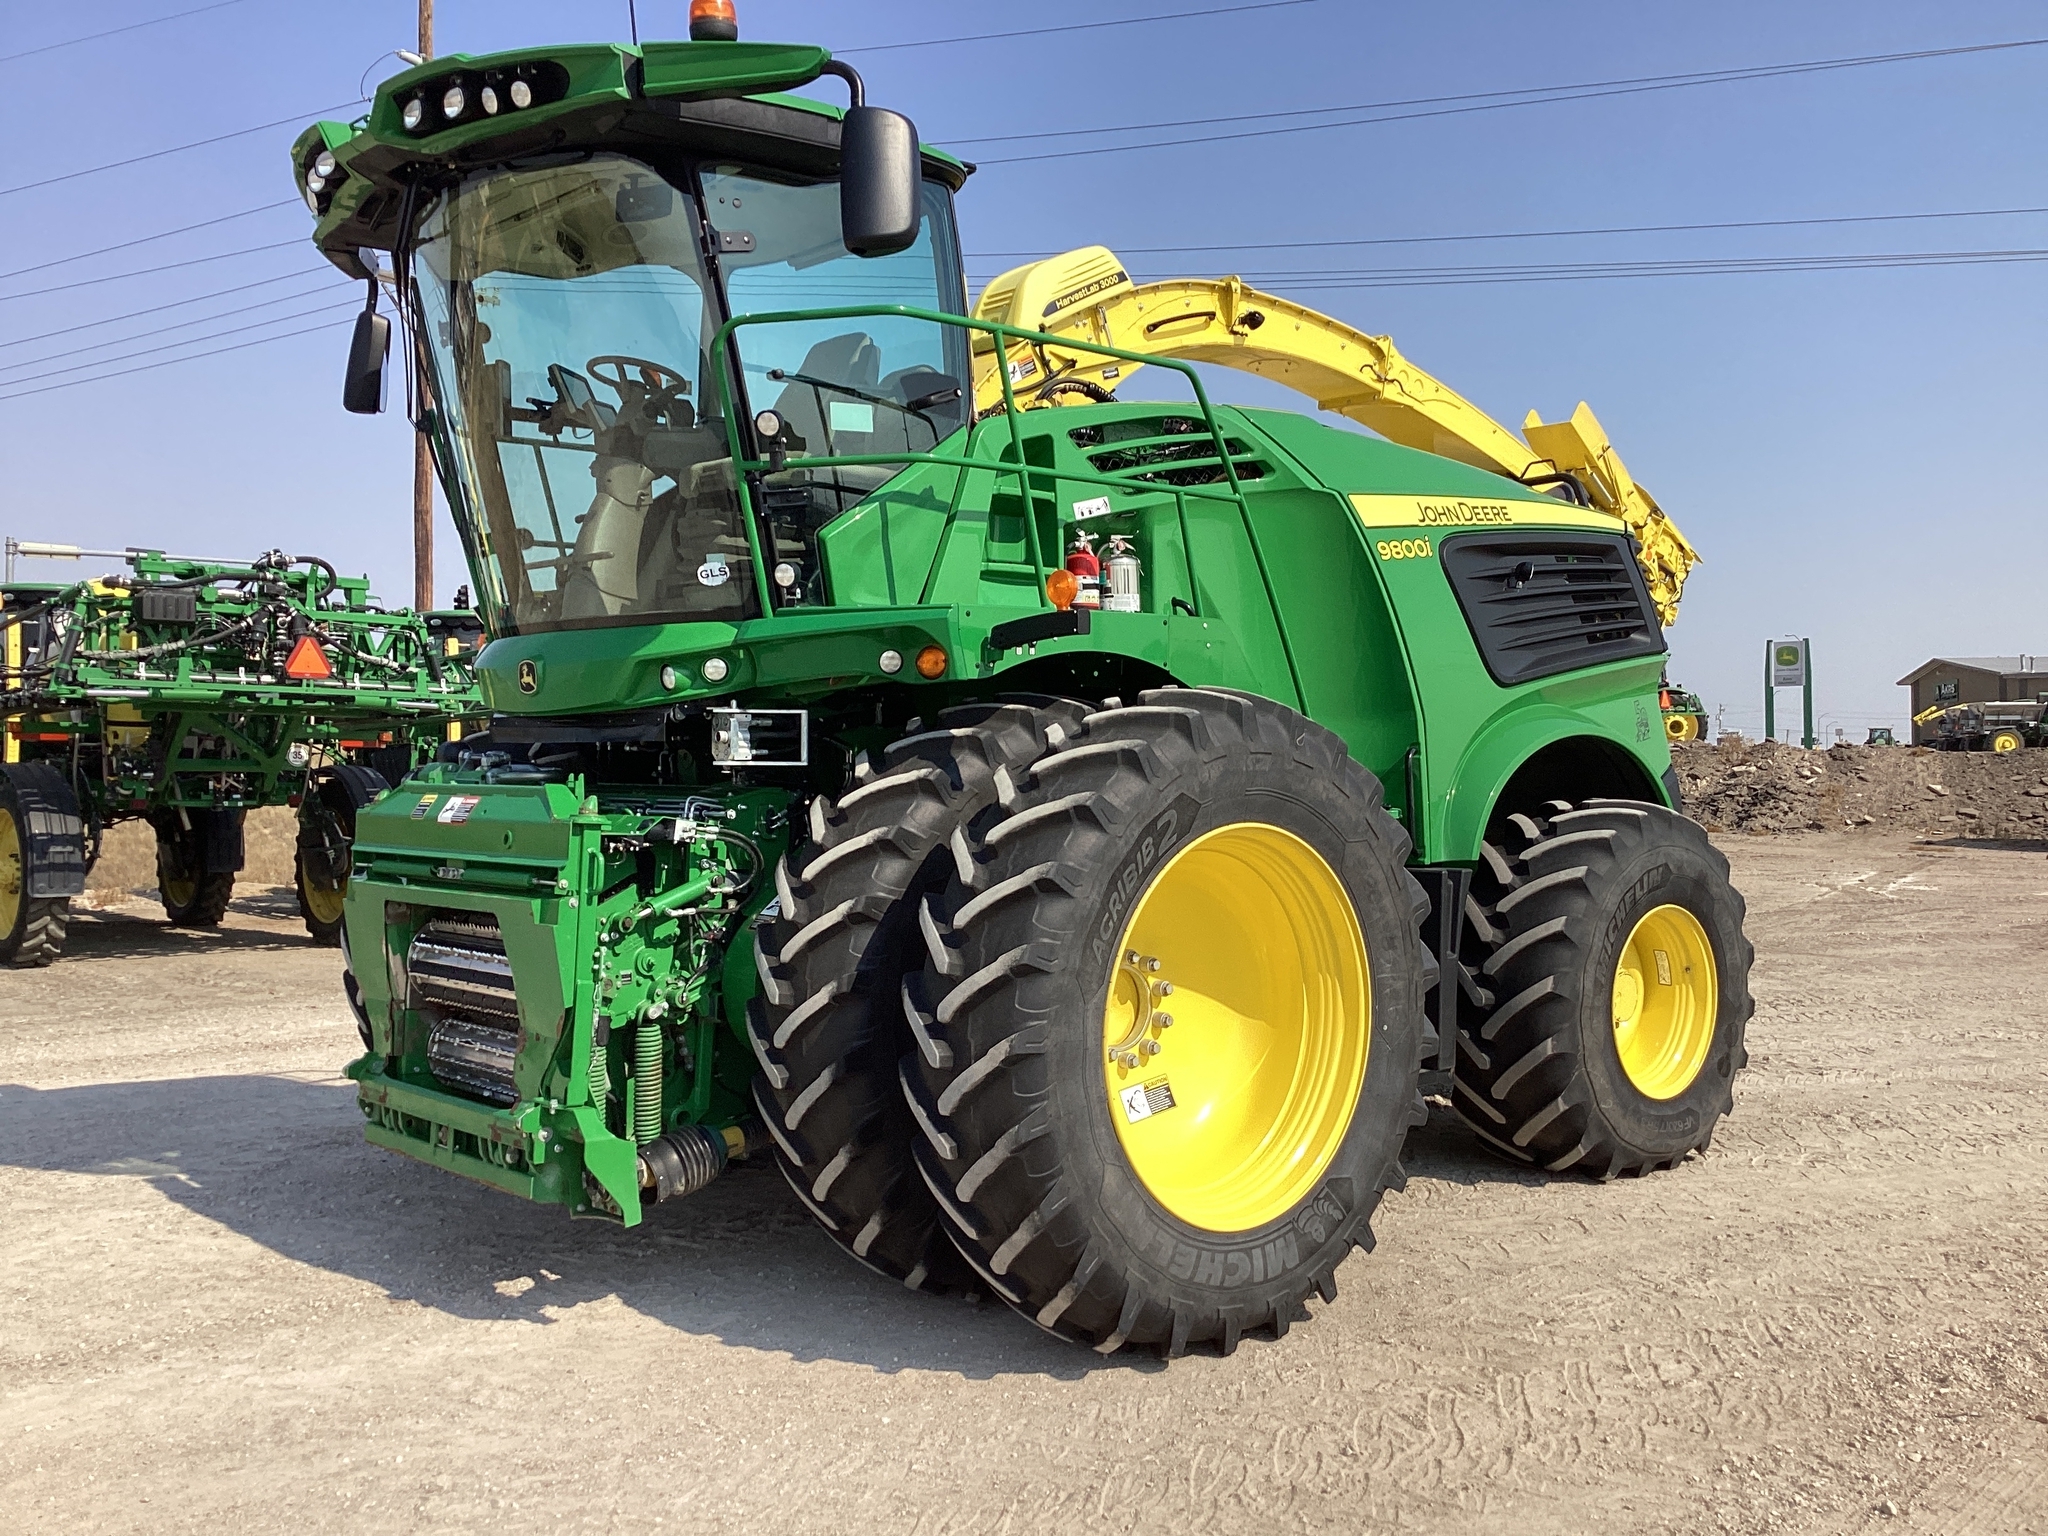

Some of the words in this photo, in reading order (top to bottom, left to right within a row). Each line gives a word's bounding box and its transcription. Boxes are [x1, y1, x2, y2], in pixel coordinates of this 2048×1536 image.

[1055, 283, 1099, 310] HarvestLab
[1100, 275, 1119, 289] 3000
[1416, 502, 1461, 523] JOHN
[1457, 502, 1513, 522] DEERE
[1376, 535, 1433, 561] 9800i
[700, 566, 728, 579] GLS
[292, 750, 303, 760] 35
[1092, 836, 1155, 966] AGRIBIB
[1156, 808, 1178, 858] 2
[1595, 865, 1663, 985] MICHELIN
[1148, 1076, 1168, 1088] CAUTION
